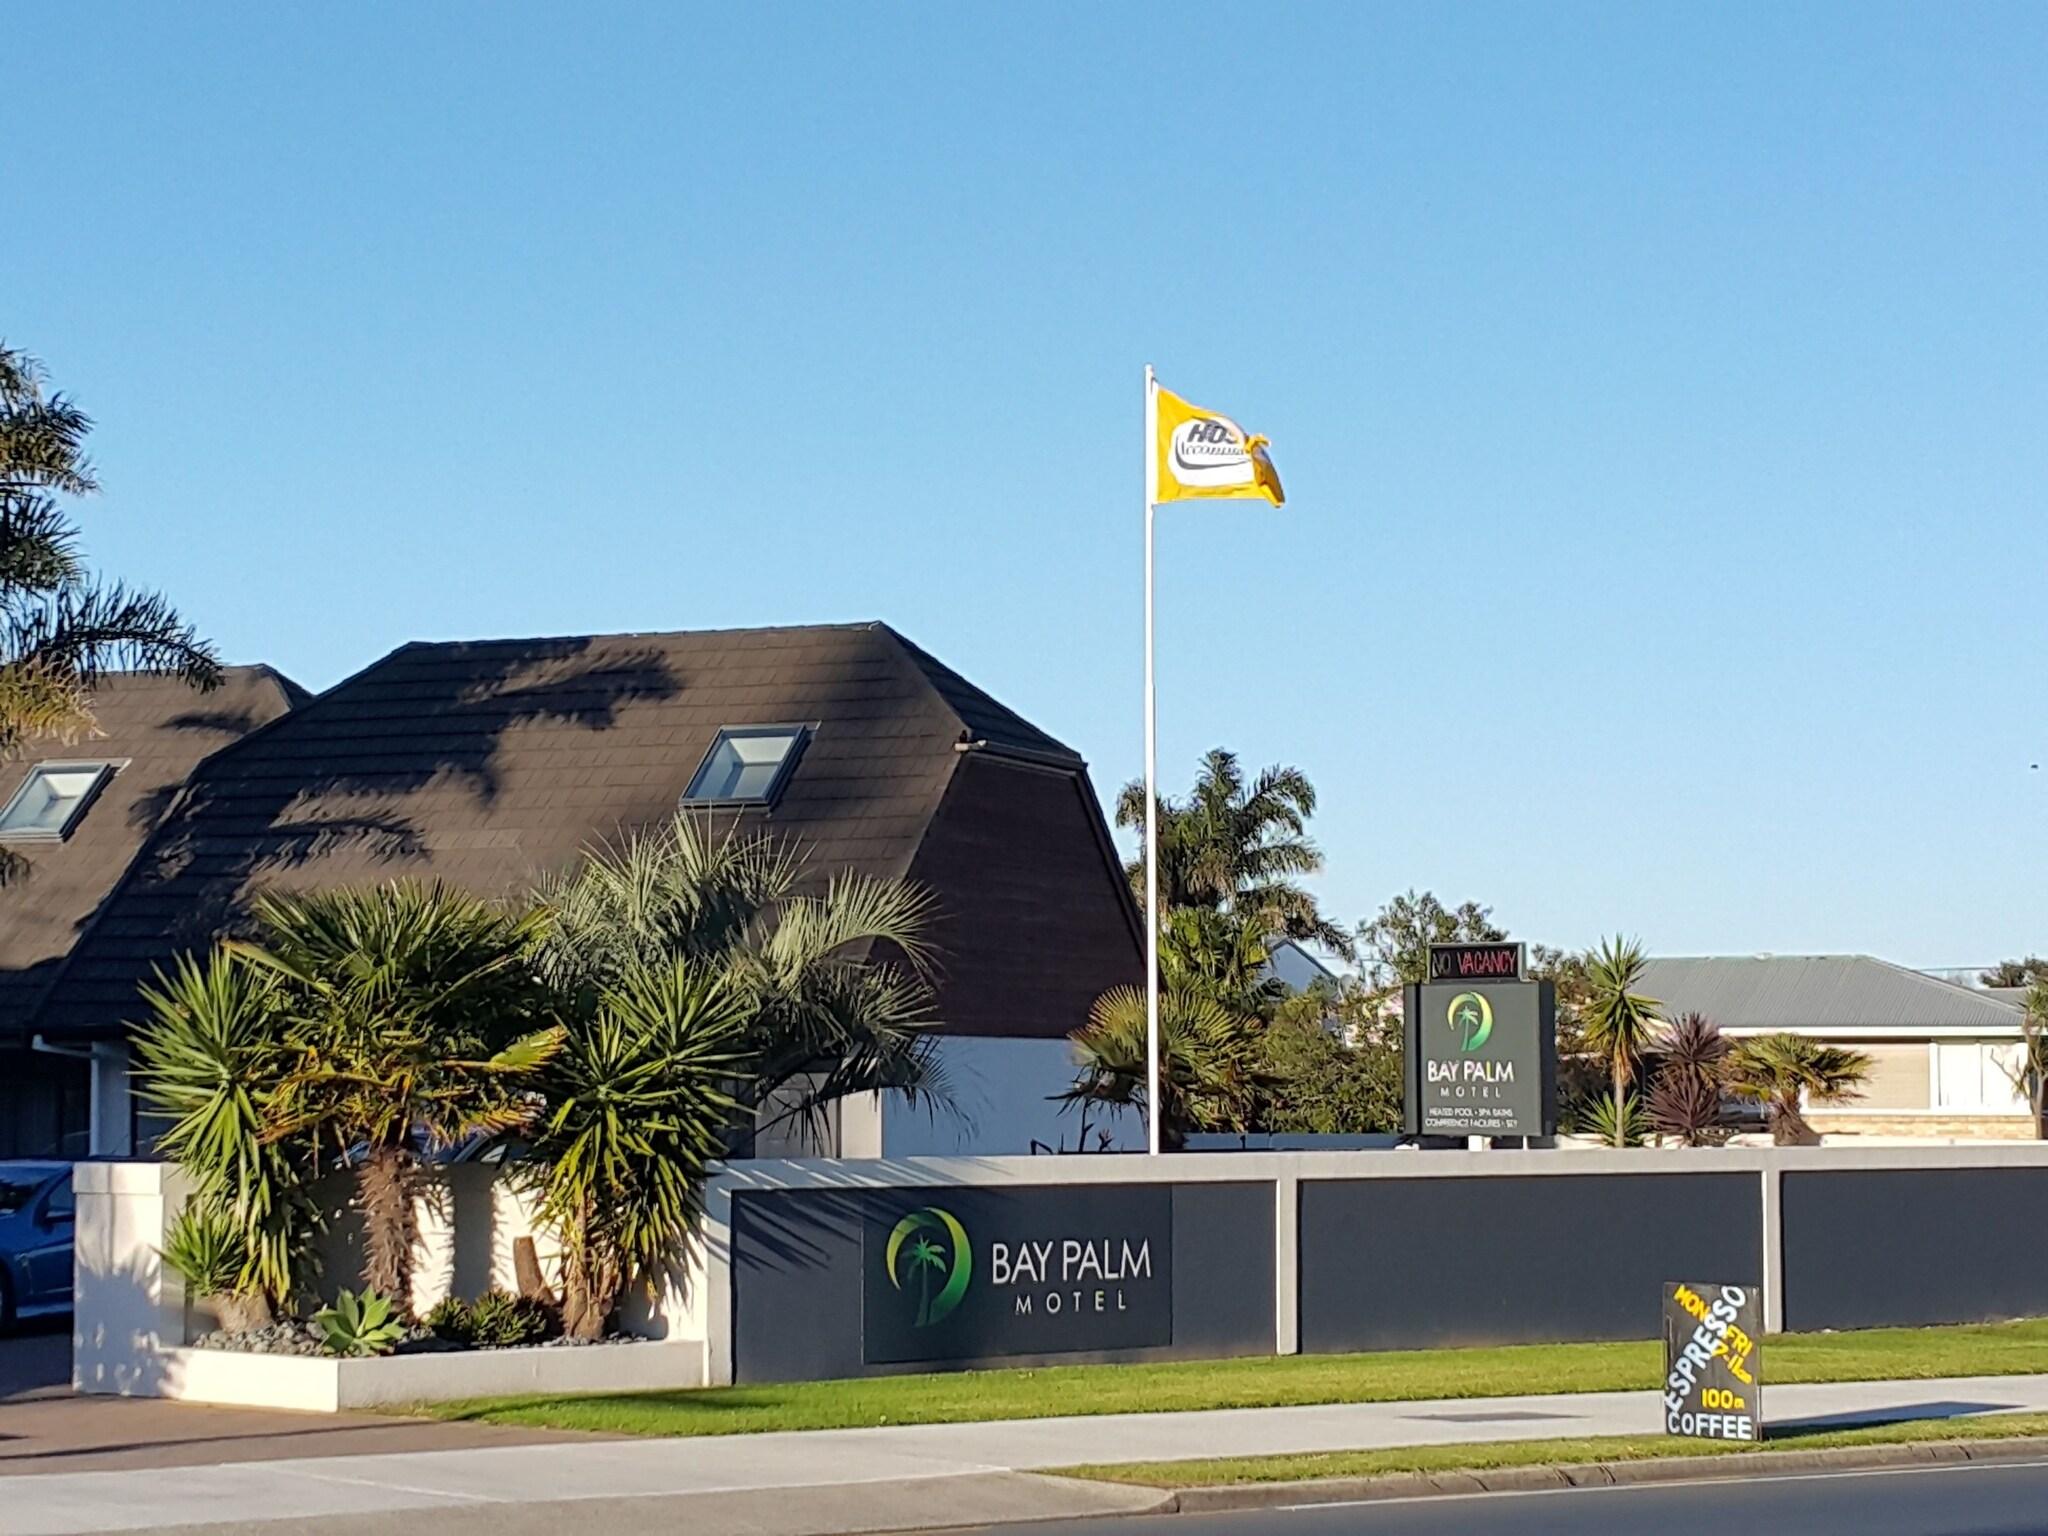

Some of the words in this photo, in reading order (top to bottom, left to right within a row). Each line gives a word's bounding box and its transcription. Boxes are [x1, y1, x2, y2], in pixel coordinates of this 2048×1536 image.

[1432, 952, 1451, 976] NO
[1457, 950, 1516, 975] VACANCY
[1428, 1060, 1459, 1082] BAY
[1464, 1061, 1514, 1082] PALM
[1440, 1086, 1501, 1098] MOTEL
[1455, 1107, 1473, 1116] POOL
[993, 1241, 1053, 1284] BAY
[1063, 1238, 1151, 1280] PALM
[1015, 1290, 1126, 1315] MOTEL
[1674, 1285, 1711, 1322] MON
[1665, 1286, 1746, 1411] ESPRESSO
[1727, 1324, 1753, 1357] FRI
[1668, 1411, 1753, 1440] COFFEE
